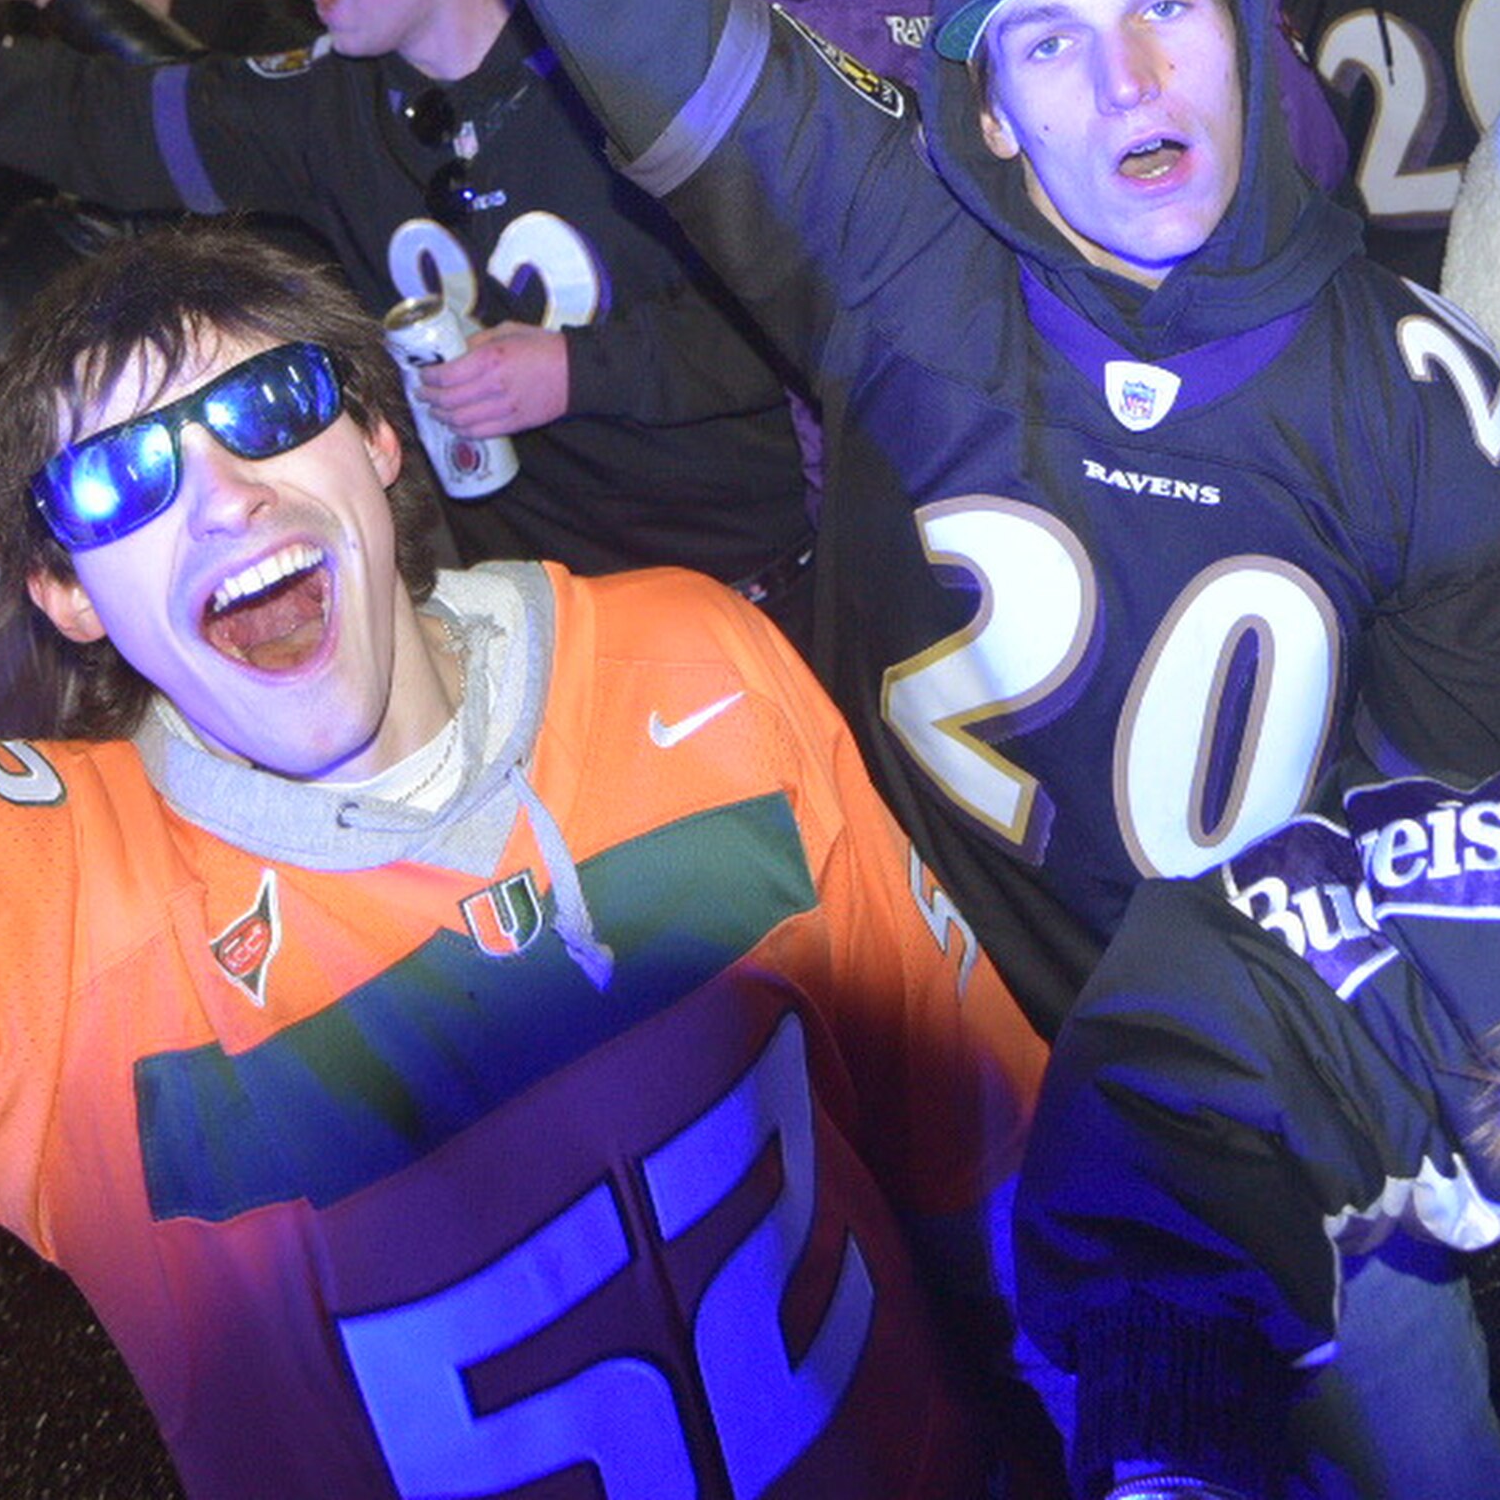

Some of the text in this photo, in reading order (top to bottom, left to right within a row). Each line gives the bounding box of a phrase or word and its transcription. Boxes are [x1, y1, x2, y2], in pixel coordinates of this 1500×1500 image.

[885, 16, 934, 48] RAV
[1082, 459, 1221, 506] RAVENS
[883, 493, 1343, 880] 20
[337, 1008, 876, 1500] 52
